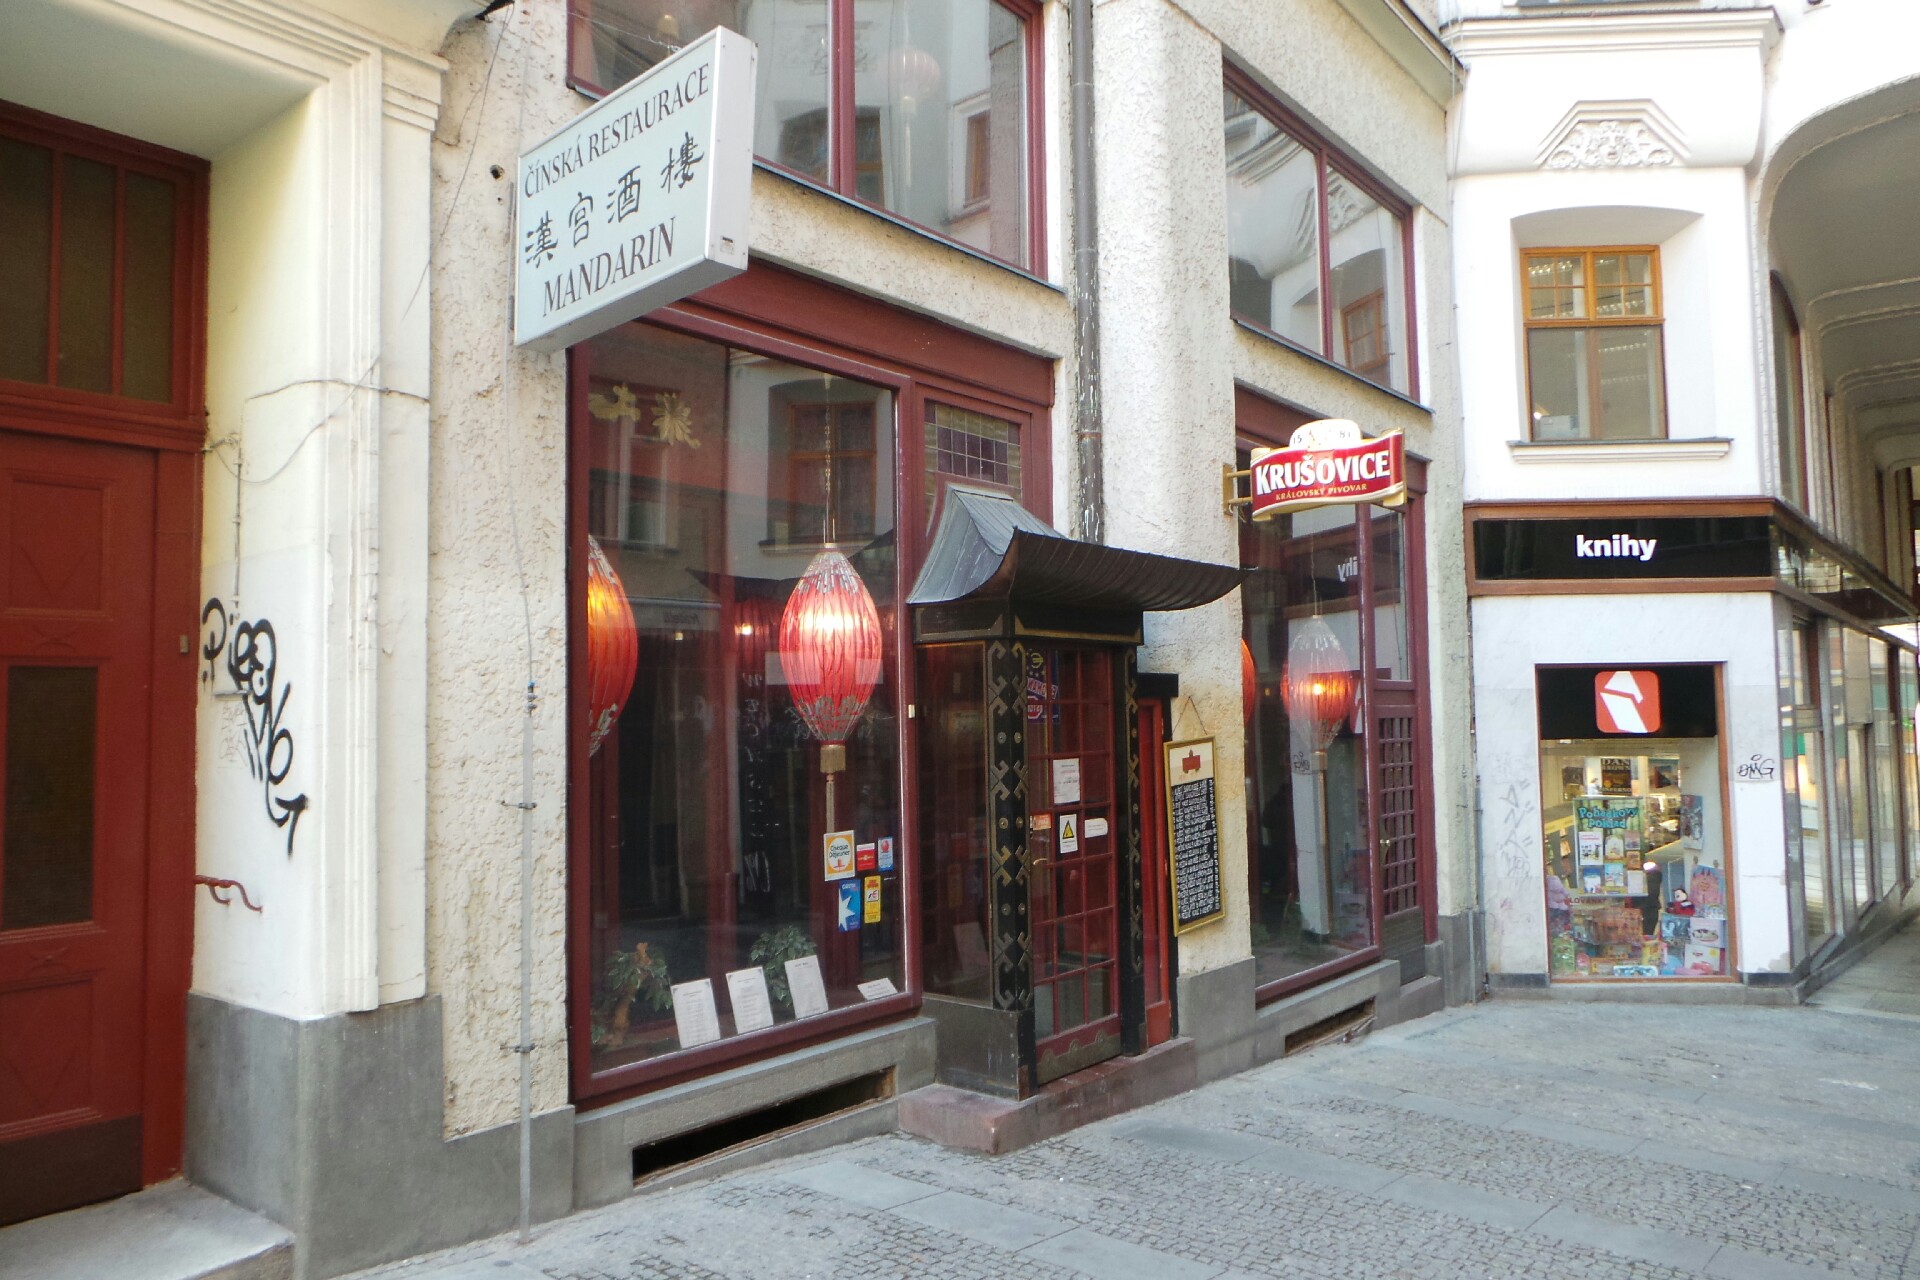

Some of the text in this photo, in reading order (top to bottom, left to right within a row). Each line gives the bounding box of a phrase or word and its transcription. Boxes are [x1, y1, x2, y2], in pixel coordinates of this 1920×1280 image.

[525, 63, 709, 198] ČÍNSKÁ RESTAURACE
[543, 216, 676, 317] MANDARIN
[1255, 450, 1391, 496] KRUŠOVICE
[1275, 483, 1368, 502] KRÁLOVSKÝ PIVOVAR
[1575, 534, 1657, 561] knihy
